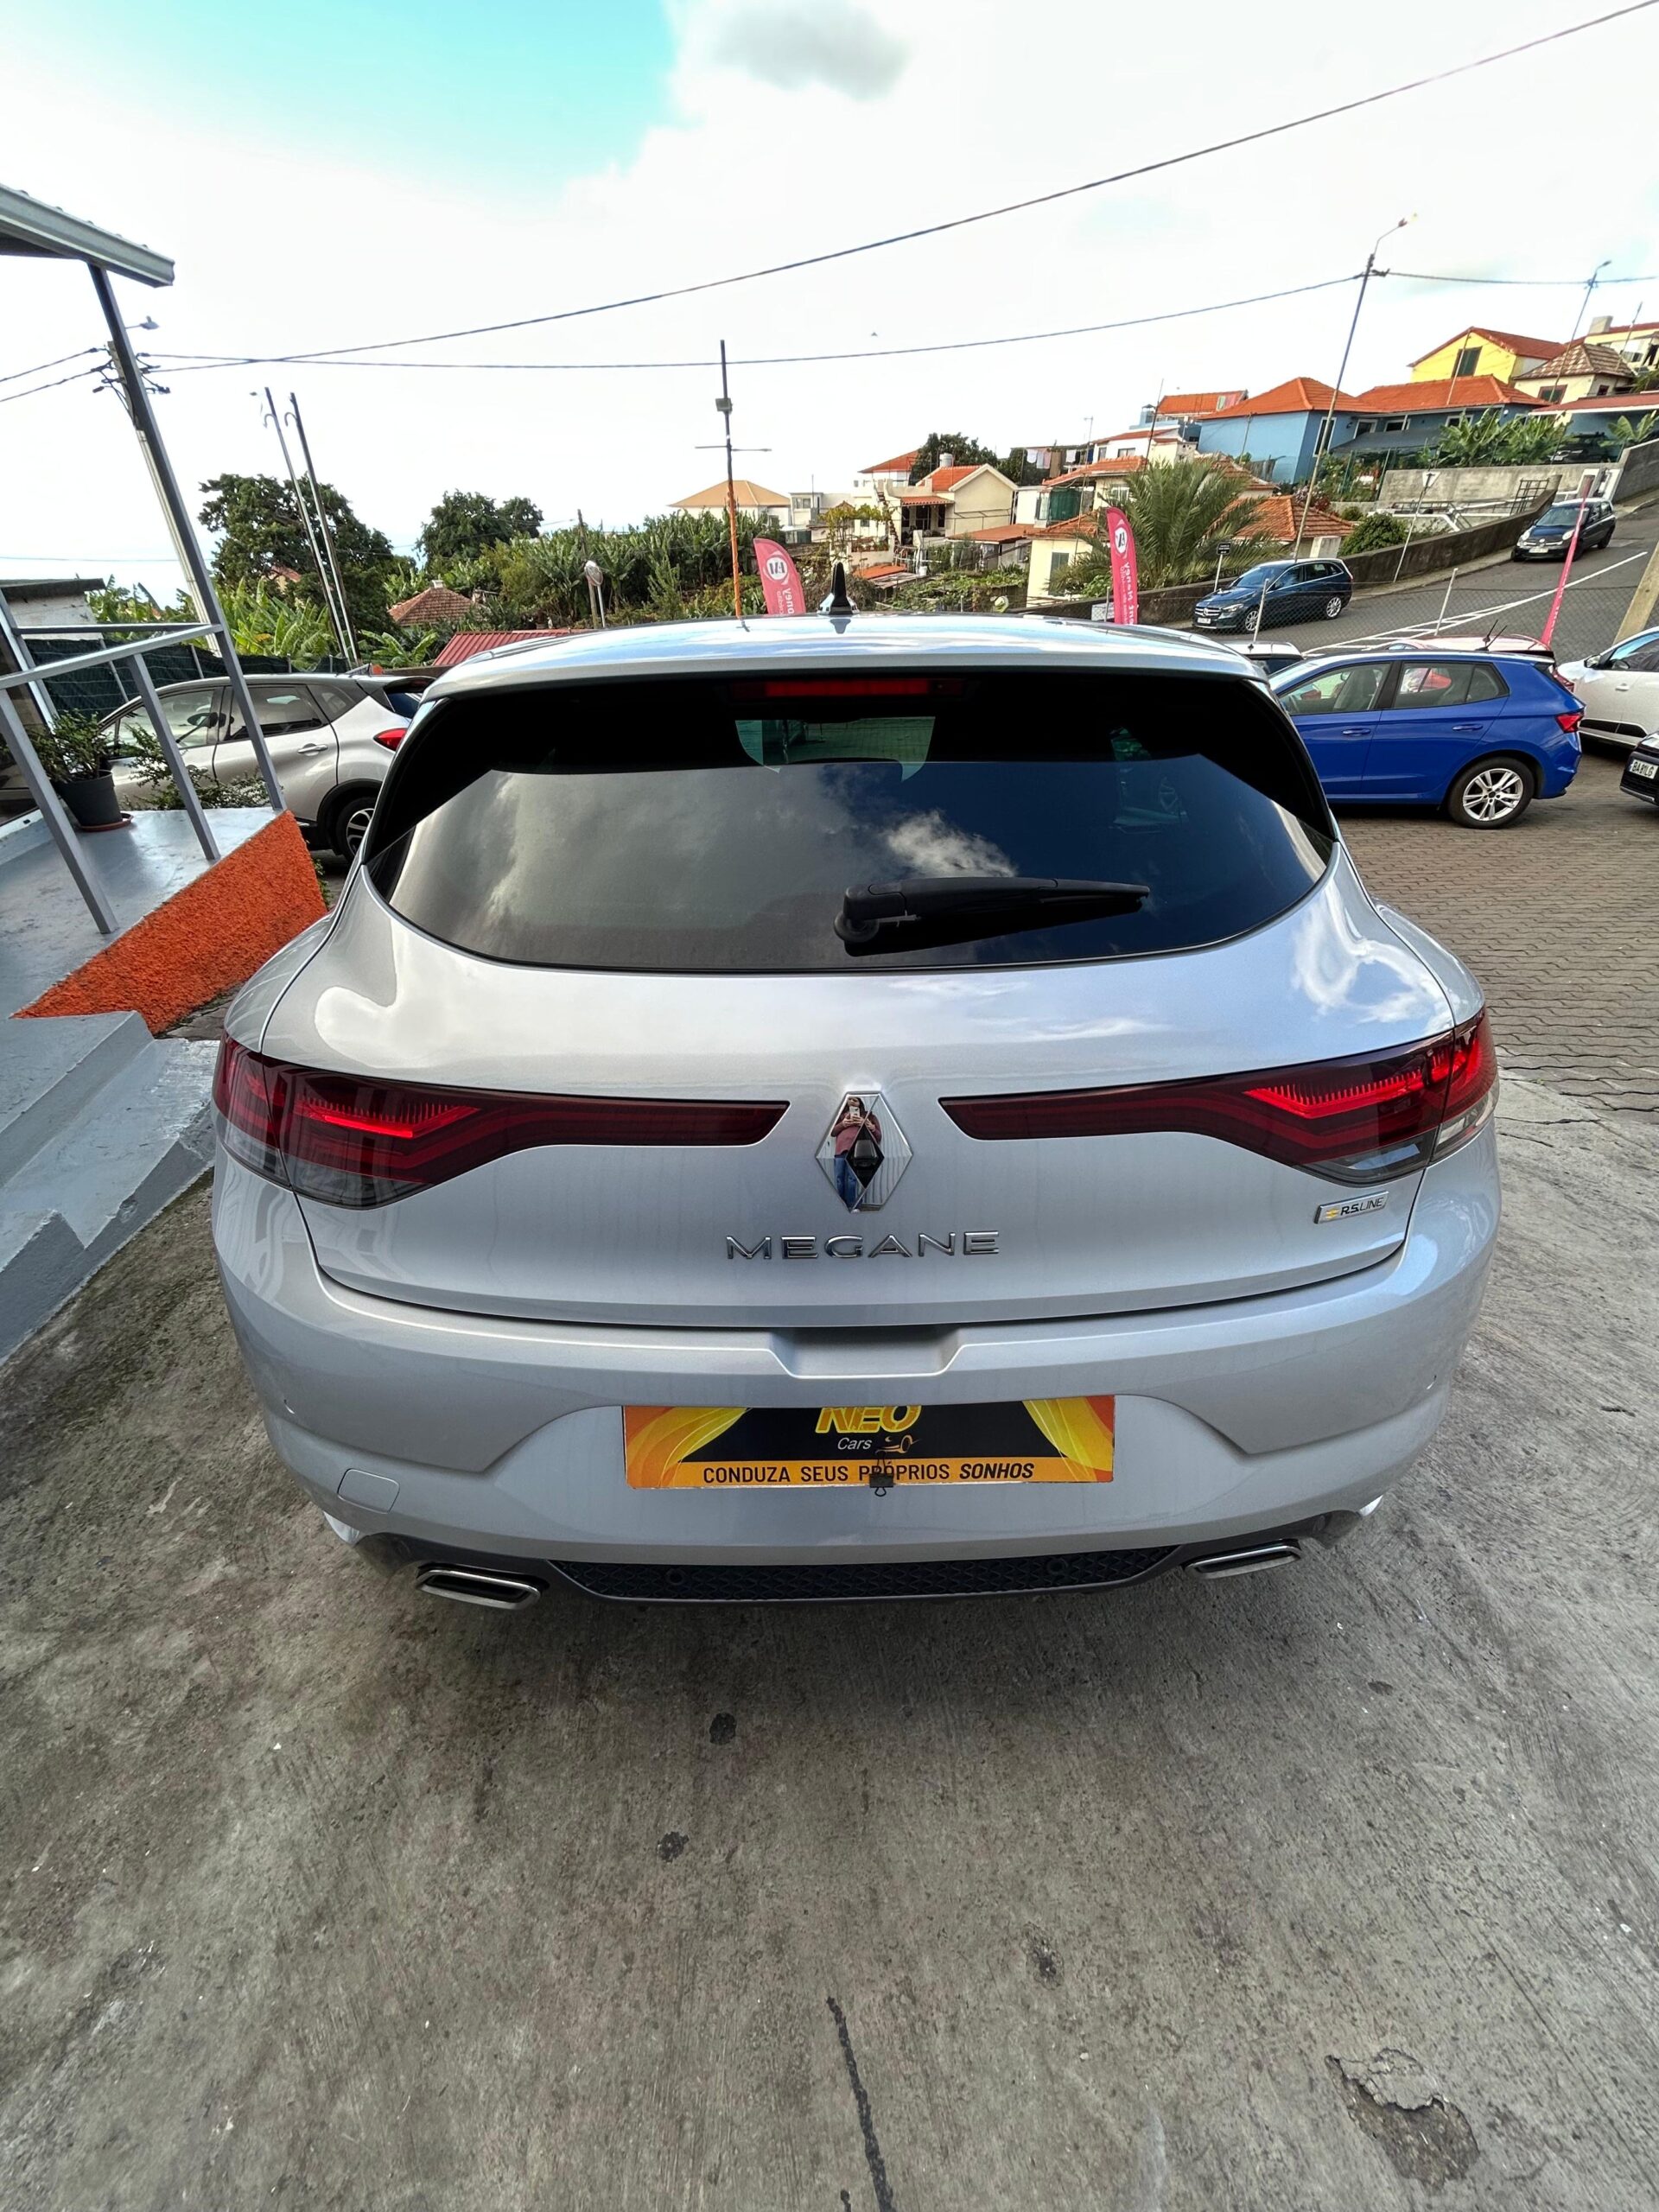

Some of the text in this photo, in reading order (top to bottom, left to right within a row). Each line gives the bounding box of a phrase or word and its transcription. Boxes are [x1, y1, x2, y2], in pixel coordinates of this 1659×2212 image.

[727, 1231, 1000, 1259] MEGANE
[815, 1406, 922, 1433] NEO
[837, 1437, 873, 1450] Cars
[703, 1466, 791, 1484] CONDUZA
[801, 1465, 849, 1482] SEUS
[959, 1463, 1034, 1479] SONHOS
